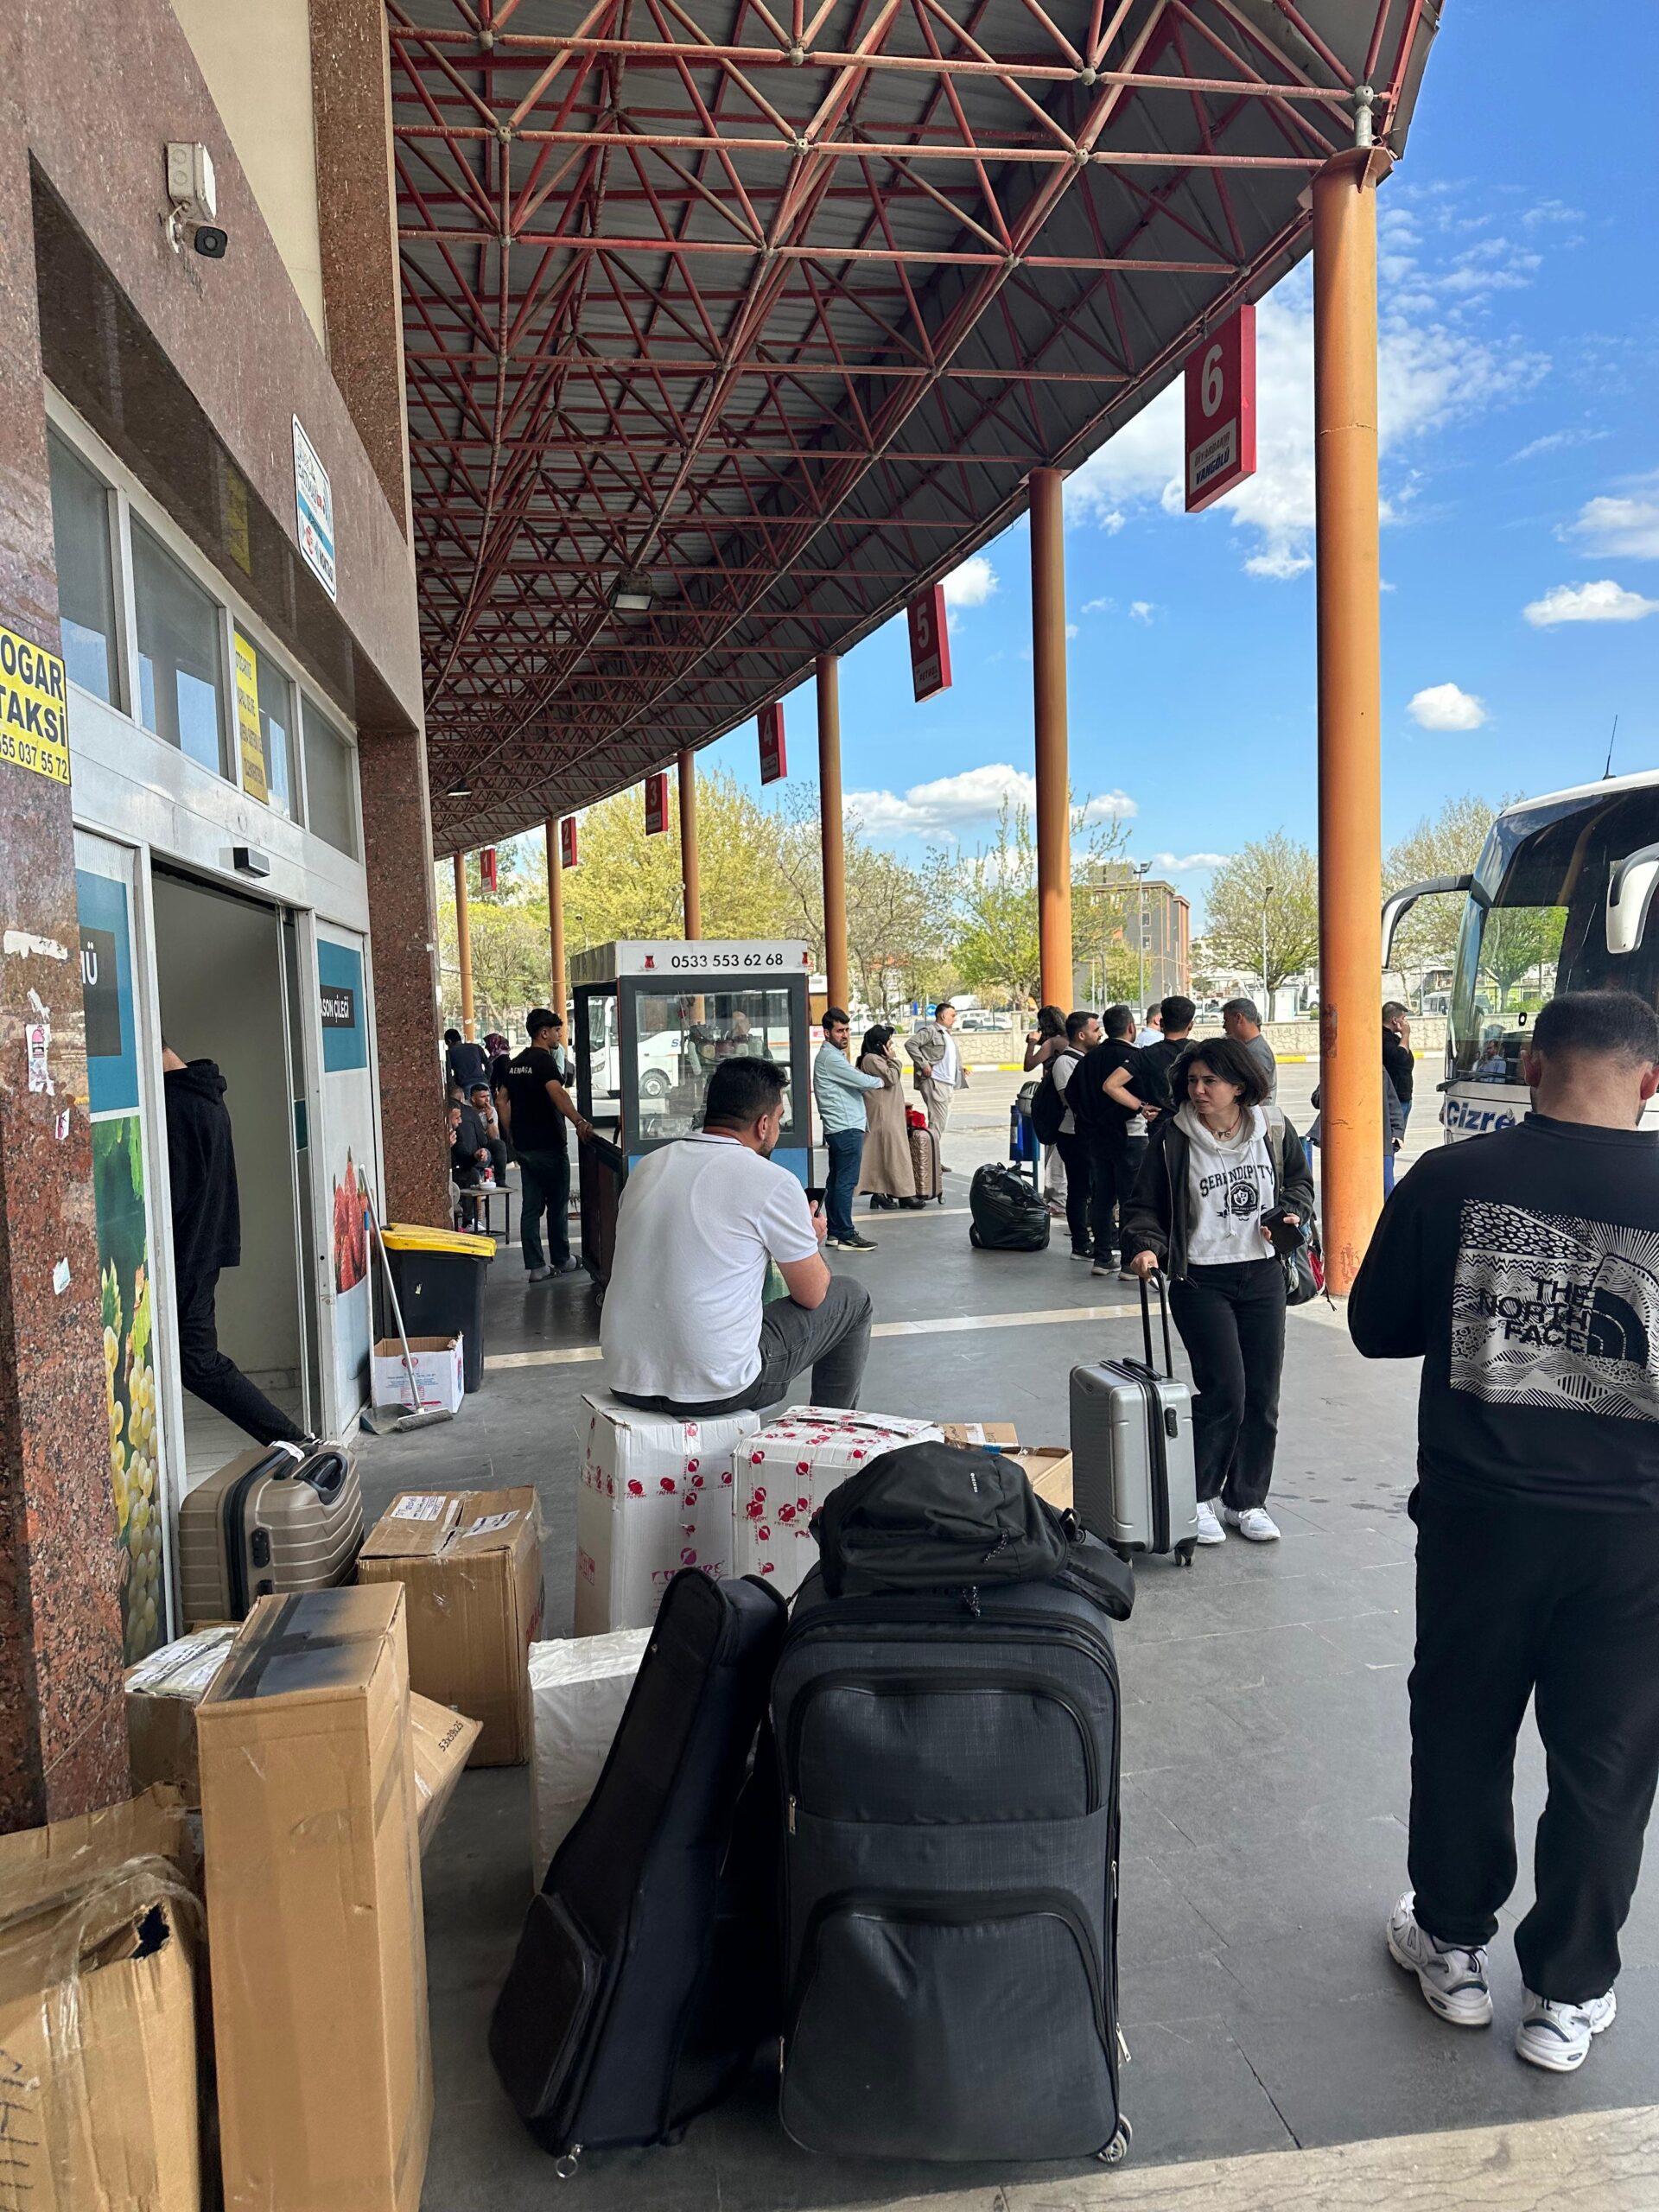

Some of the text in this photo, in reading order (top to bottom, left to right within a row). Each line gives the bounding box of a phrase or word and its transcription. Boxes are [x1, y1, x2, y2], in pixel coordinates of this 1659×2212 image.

[1201, 344, 1224, 417] 6
[1195, 448, 1230, 485] VANGÖLÜ
[917, 602, 930, 649] 5
[0, 634, 64, 702] OGAR
[763, 714, 773, 746] 4
[18, 741, 37, 767] 037
[41, 750, 54, 774] 55
[55, 756, 68, 780] 72
[650, 780, 658, 807] 3
[563, 823, 569, 845] 2
[484, 853, 488, 873] 1
[671, 953, 784, 969] 0533 553 62 68
[1446, 1100, 1516, 1131] Cizre
[1530, 1275, 1594, 1306] THE
[1478, 1287, 1592, 1332] NORTH
[1500, 1318, 1590, 1354] FACE
